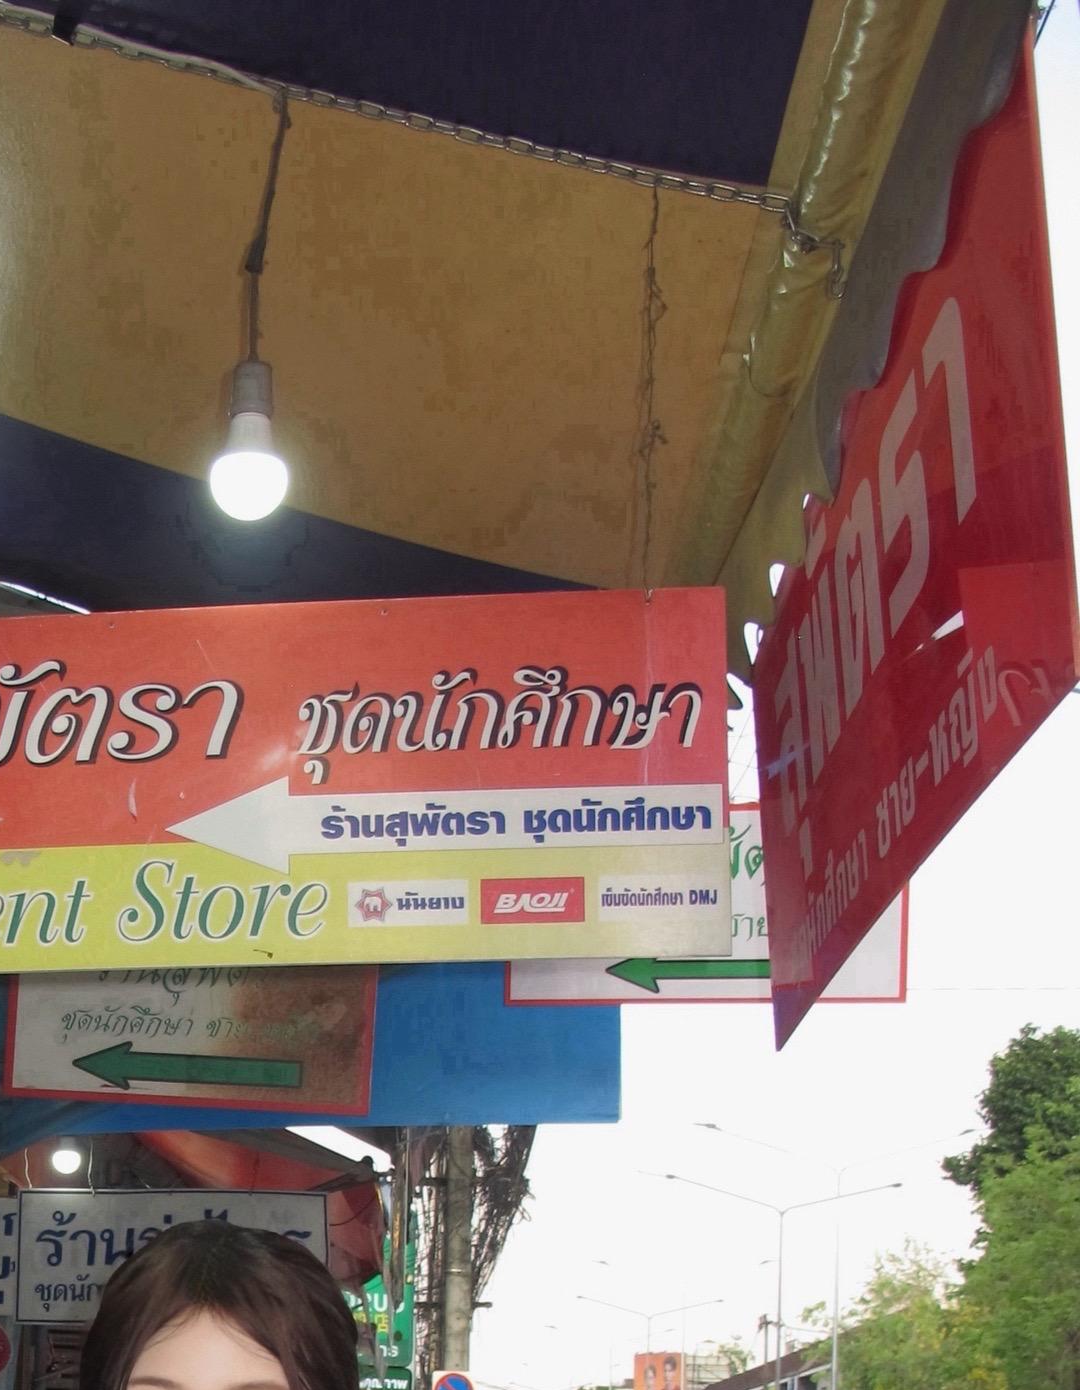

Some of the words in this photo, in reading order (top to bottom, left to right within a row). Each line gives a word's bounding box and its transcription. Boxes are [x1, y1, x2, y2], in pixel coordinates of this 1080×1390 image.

[297, 665, 706, 785] ชุดนักศึกษา
[320, 803, 506, 847] ร้านสุพัตรา
[523, 797, 712, 843] ชุดนักศึกษา
[118, 860, 328, 945] Store
[396, 891, 465, 910] นันยาง
[493, 891, 569, 914] BAOJI
[689, 888, 718, 906] DMJ
